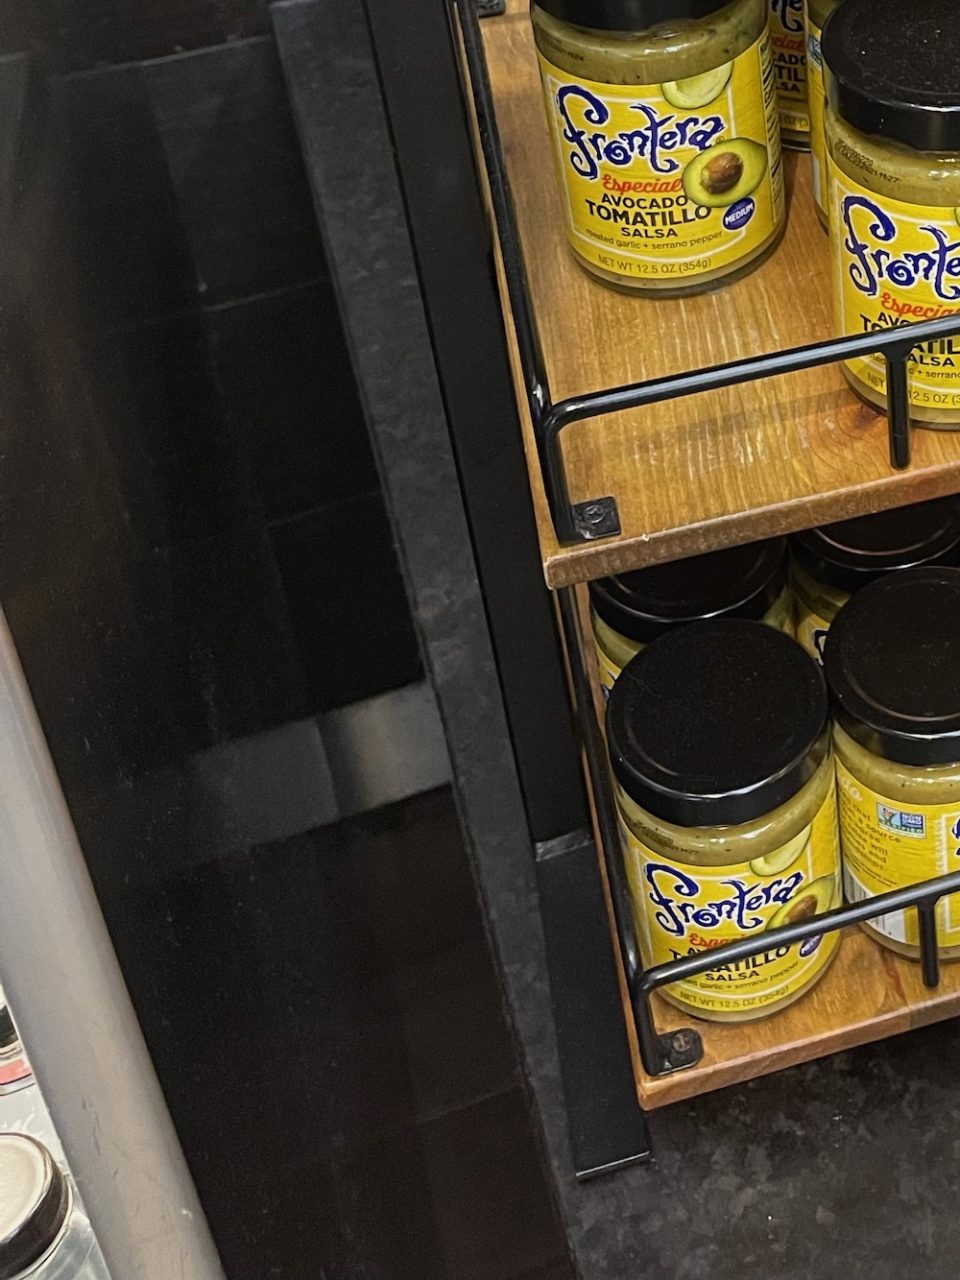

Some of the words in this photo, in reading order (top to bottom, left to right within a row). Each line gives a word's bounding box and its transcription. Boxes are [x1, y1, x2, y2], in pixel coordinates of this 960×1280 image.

[602, 174, 684, 196] Especial
[601, 193, 689, 210] AVOCADO
[585, 199, 712, 228] TOMATILLO
[725, 202, 754, 225] MEDIUM
[586, 228, 615, 246] roasted
[617, 236, 642, 250] garlic
[652, 240, 689, 250] serrano
[690, 230, 724, 249] pepper
[621, 227, 679, 239] SALSA
[598, 253, 615, 269] NET
[617, 260, 634, 273] WT
[637, 263, 659, 274] 12.5
[661, 263, 678, 274] OZ
[679, 257, 713, 274] (354g)
[866, 372, 884, 388] NET
[908, 391, 931, 402] 12.5
[932, 392, 949, 404] OZ
[705, 970, 760, 982] SALSA
[699, 997, 716, 1008] WT
[719, 998, 741, 1009] 12.5
[742, 996, 757, 1007] OZ
